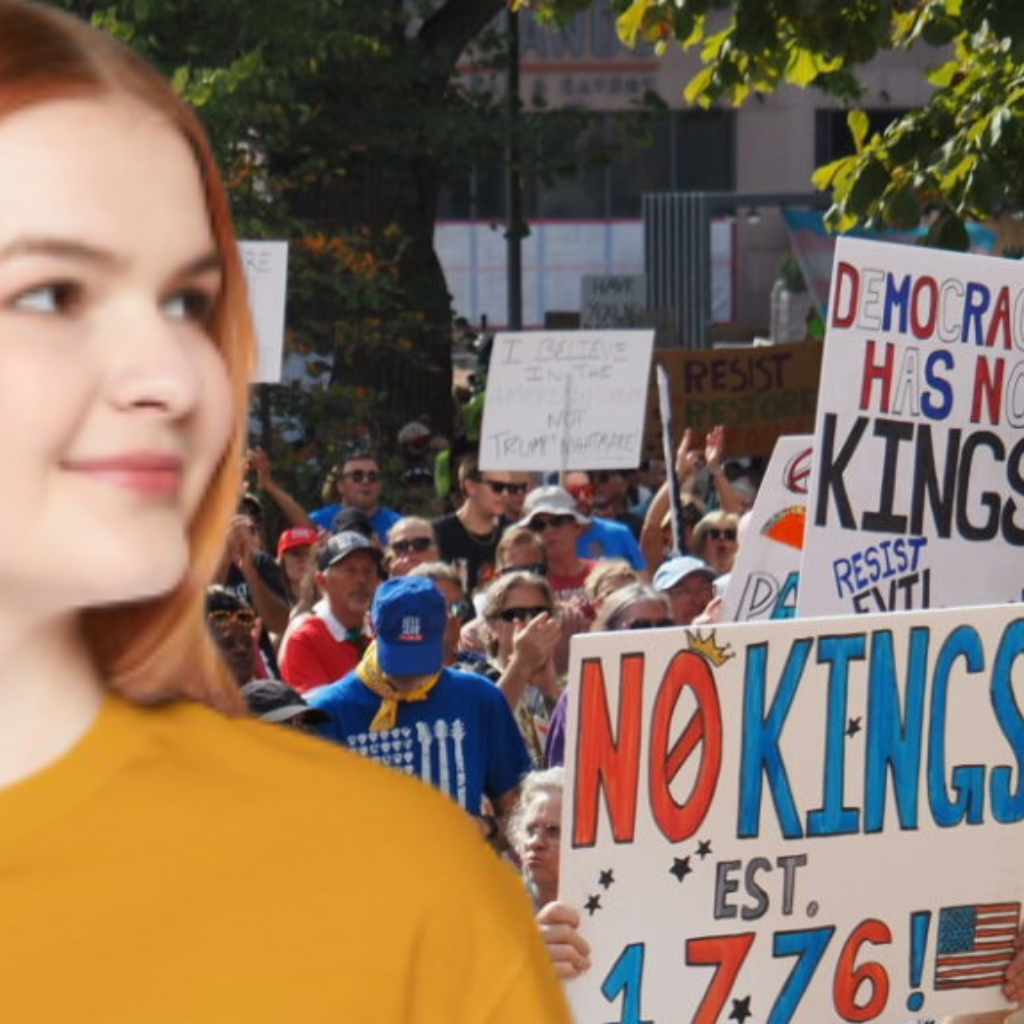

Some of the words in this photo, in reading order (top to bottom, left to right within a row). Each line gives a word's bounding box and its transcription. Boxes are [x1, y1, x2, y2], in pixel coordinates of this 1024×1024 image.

[685, 353, 794, 393] RESIST
[859, 340, 955, 421] HAS
[814, 412, 1024, 547] KINGS
[833, 537, 928, 598] RESIST
[571, 648, 723, 849] NO
[736, 618, 1024, 840] KINGS
[713, 853, 818, 921] EST.
